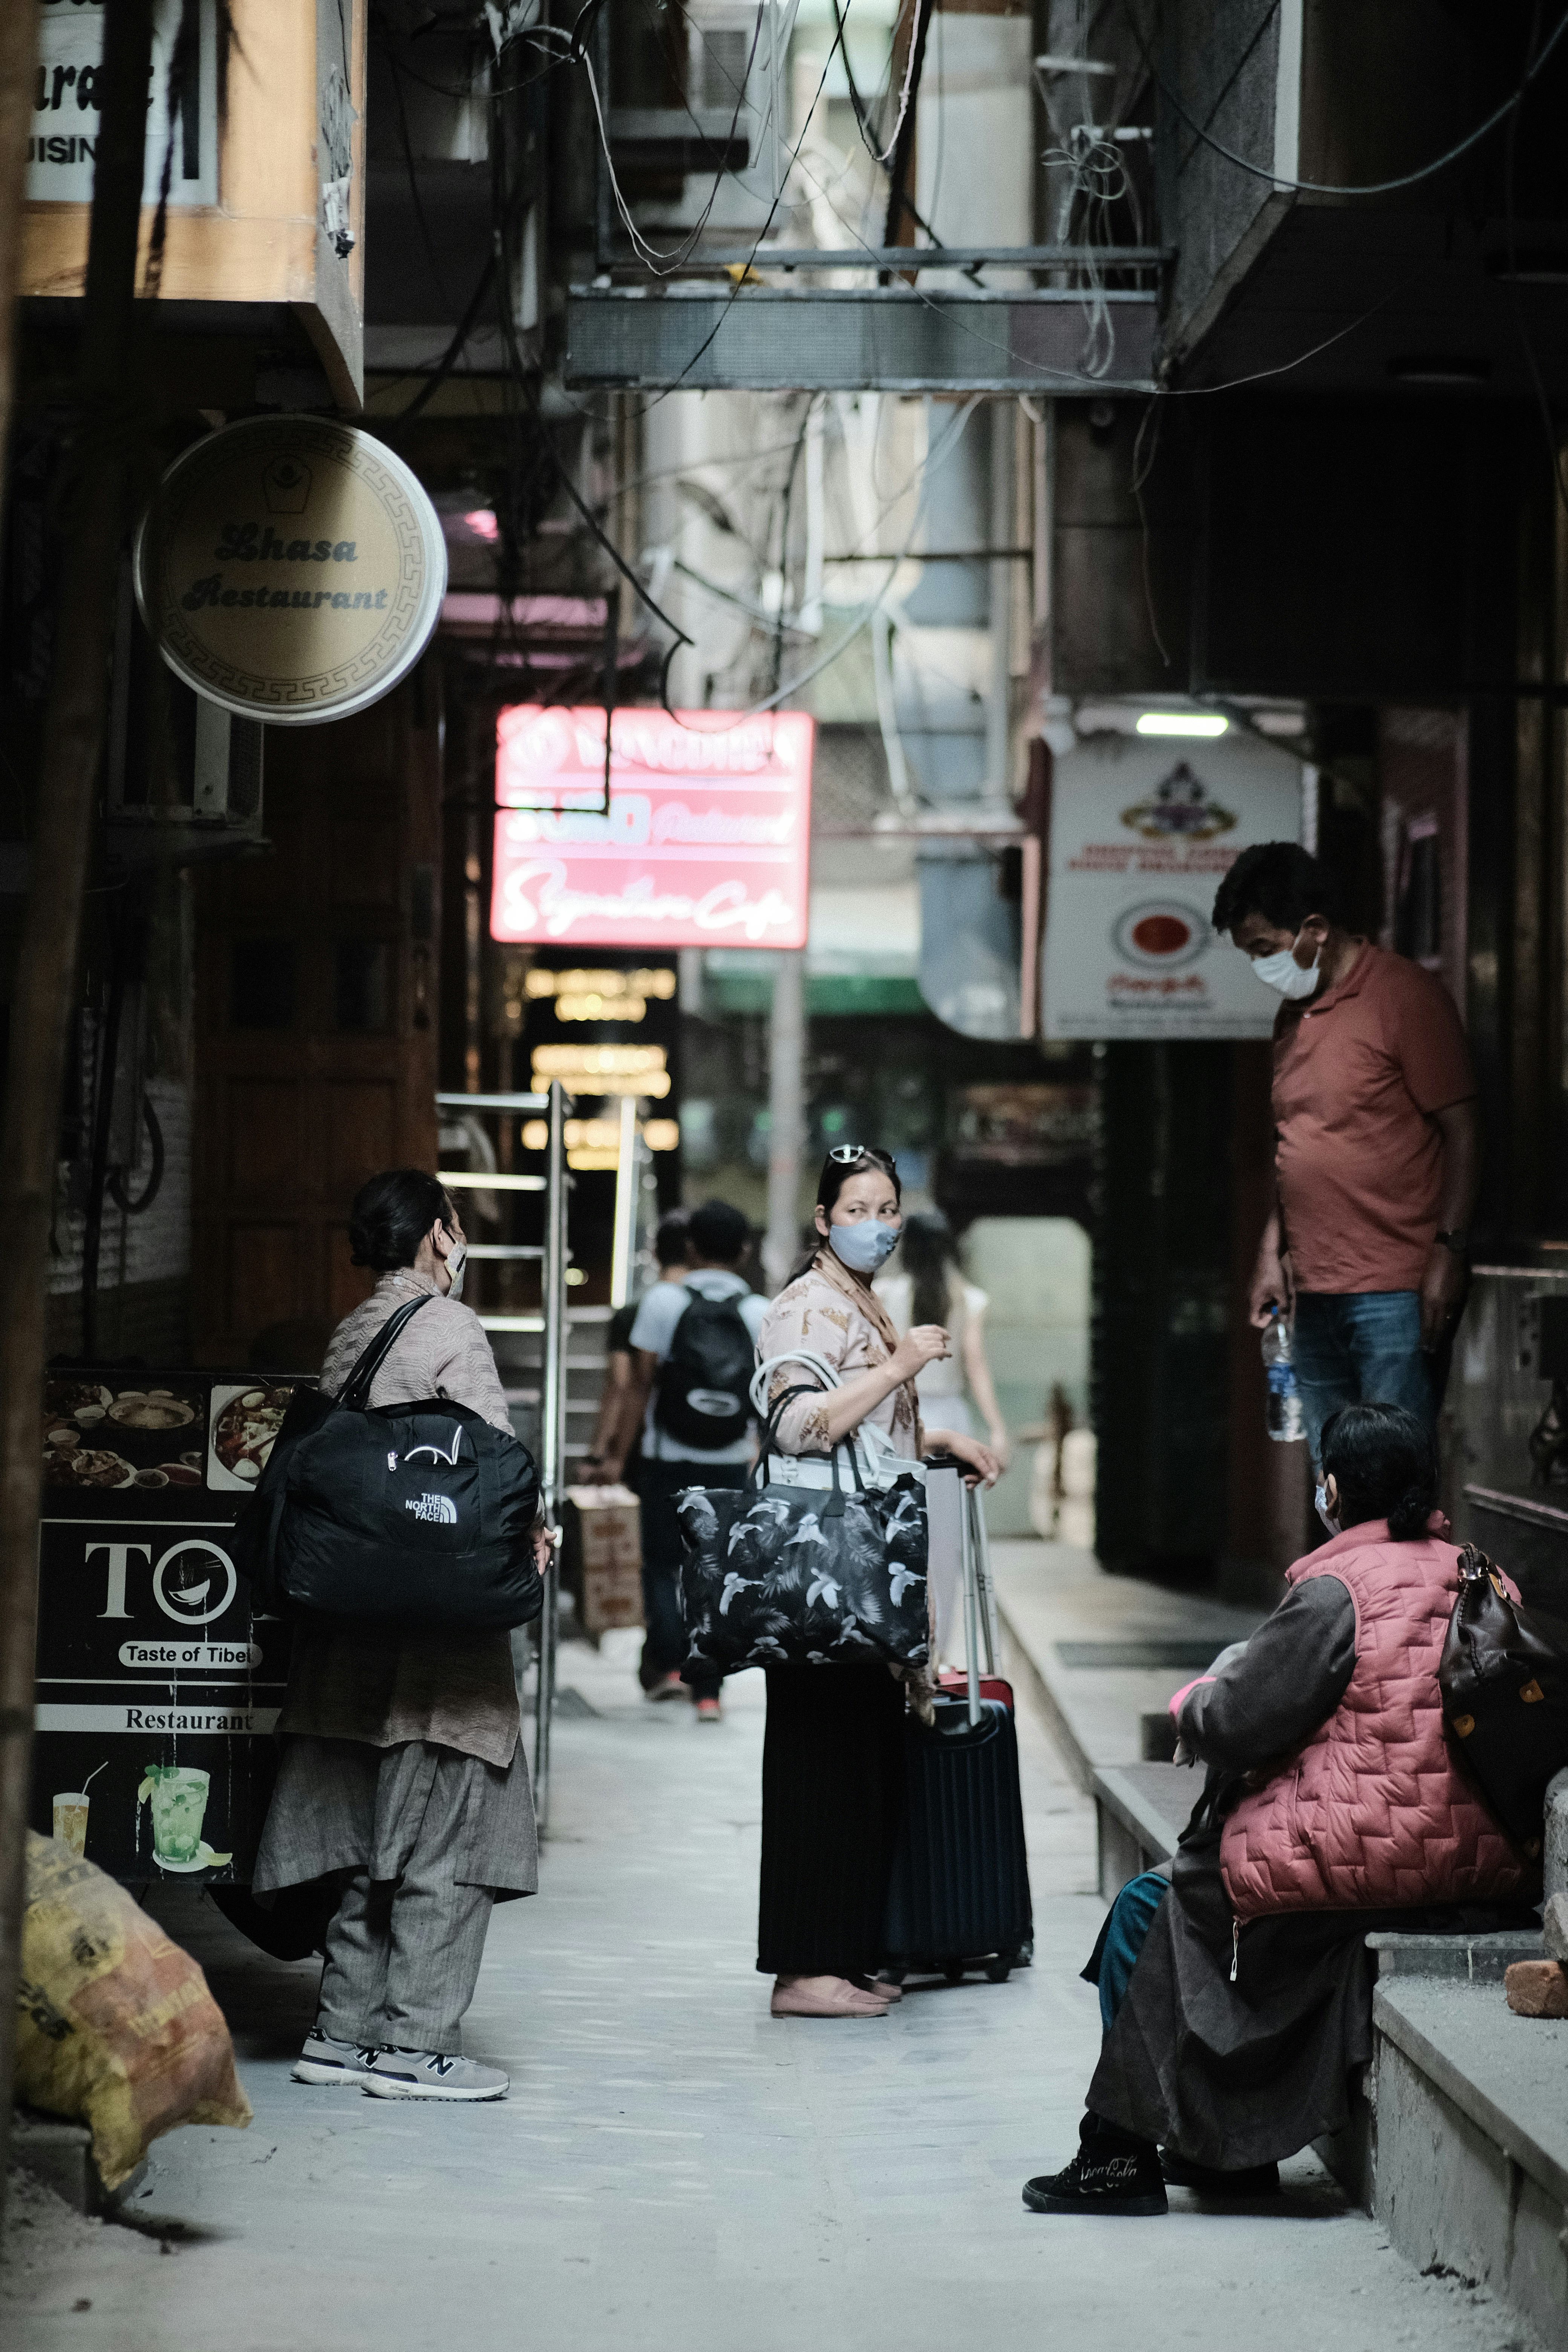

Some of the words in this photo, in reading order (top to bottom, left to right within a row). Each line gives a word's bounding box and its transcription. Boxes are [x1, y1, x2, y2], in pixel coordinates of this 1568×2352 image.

[214, 522, 357, 562] Lhasa
[182, 573, 387, 611] Restaurant
[405, 1499, 440, 1513] NORTH
[421, 1493, 441, 1504] THE
[415, 1510, 439, 1522] FACE
[85, 1539, 281, 1625] TO
[127, 1646, 176, 1662] Taste
[182, 1647, 201, 1662] of
[126, 1709, 253, 1730] Restaurant
[425, 2053, 456, 2078] N
